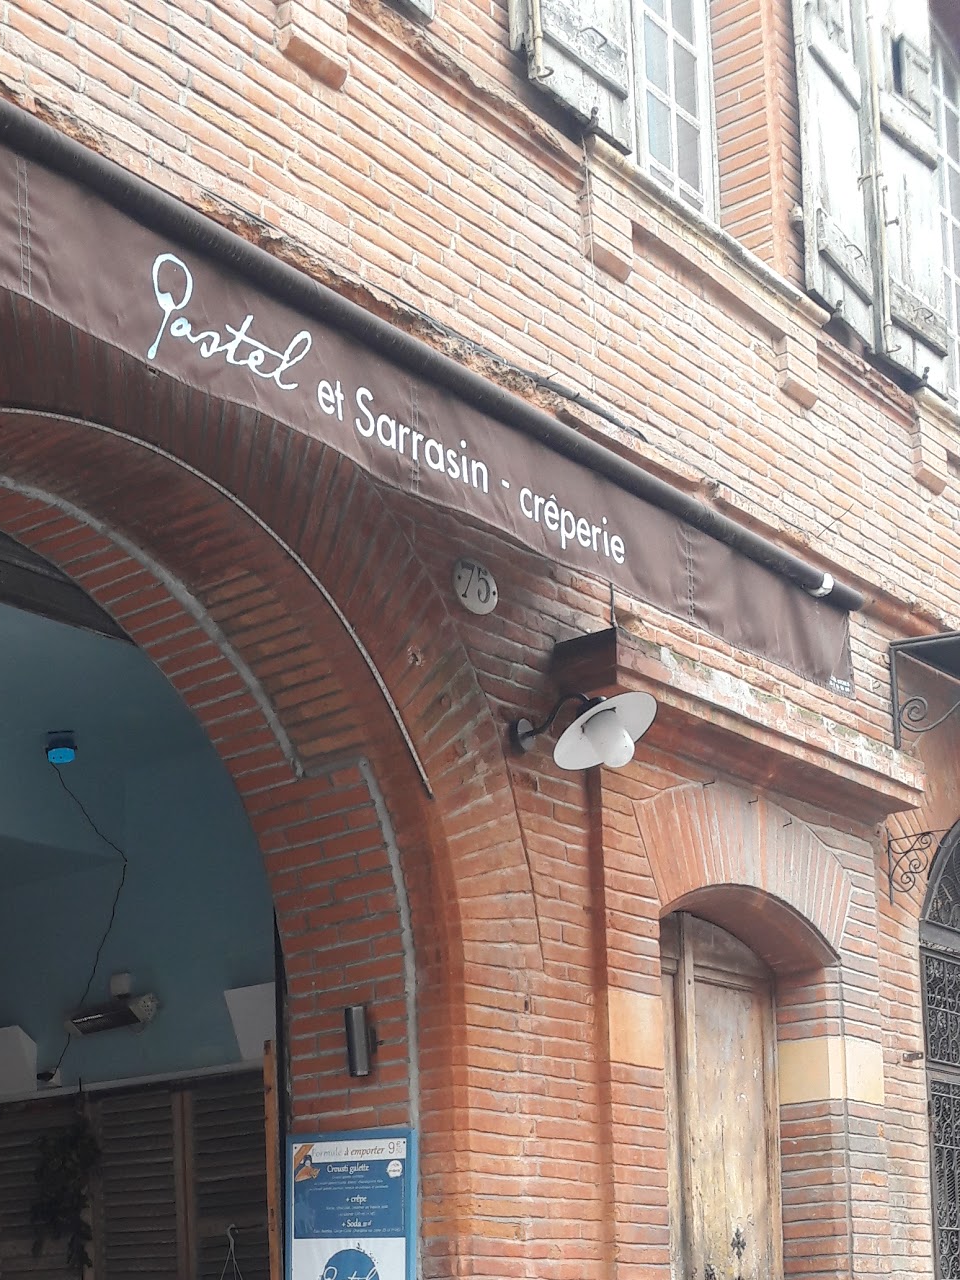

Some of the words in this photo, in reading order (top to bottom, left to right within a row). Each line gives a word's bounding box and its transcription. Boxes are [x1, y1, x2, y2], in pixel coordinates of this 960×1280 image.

[146, 253, 312, 390] Pastel
[317, 379, 345, 422] et
[355, 387, 489, 495] Sarrasin
[519, 485, 626, 565] crêperie
[460, 561, 491, 604] 75
[350, 1145, 385, 1158] emporter
[326, 1163, 349, 1173] Crousti
[346, 1217, 361, 1228] Soda
